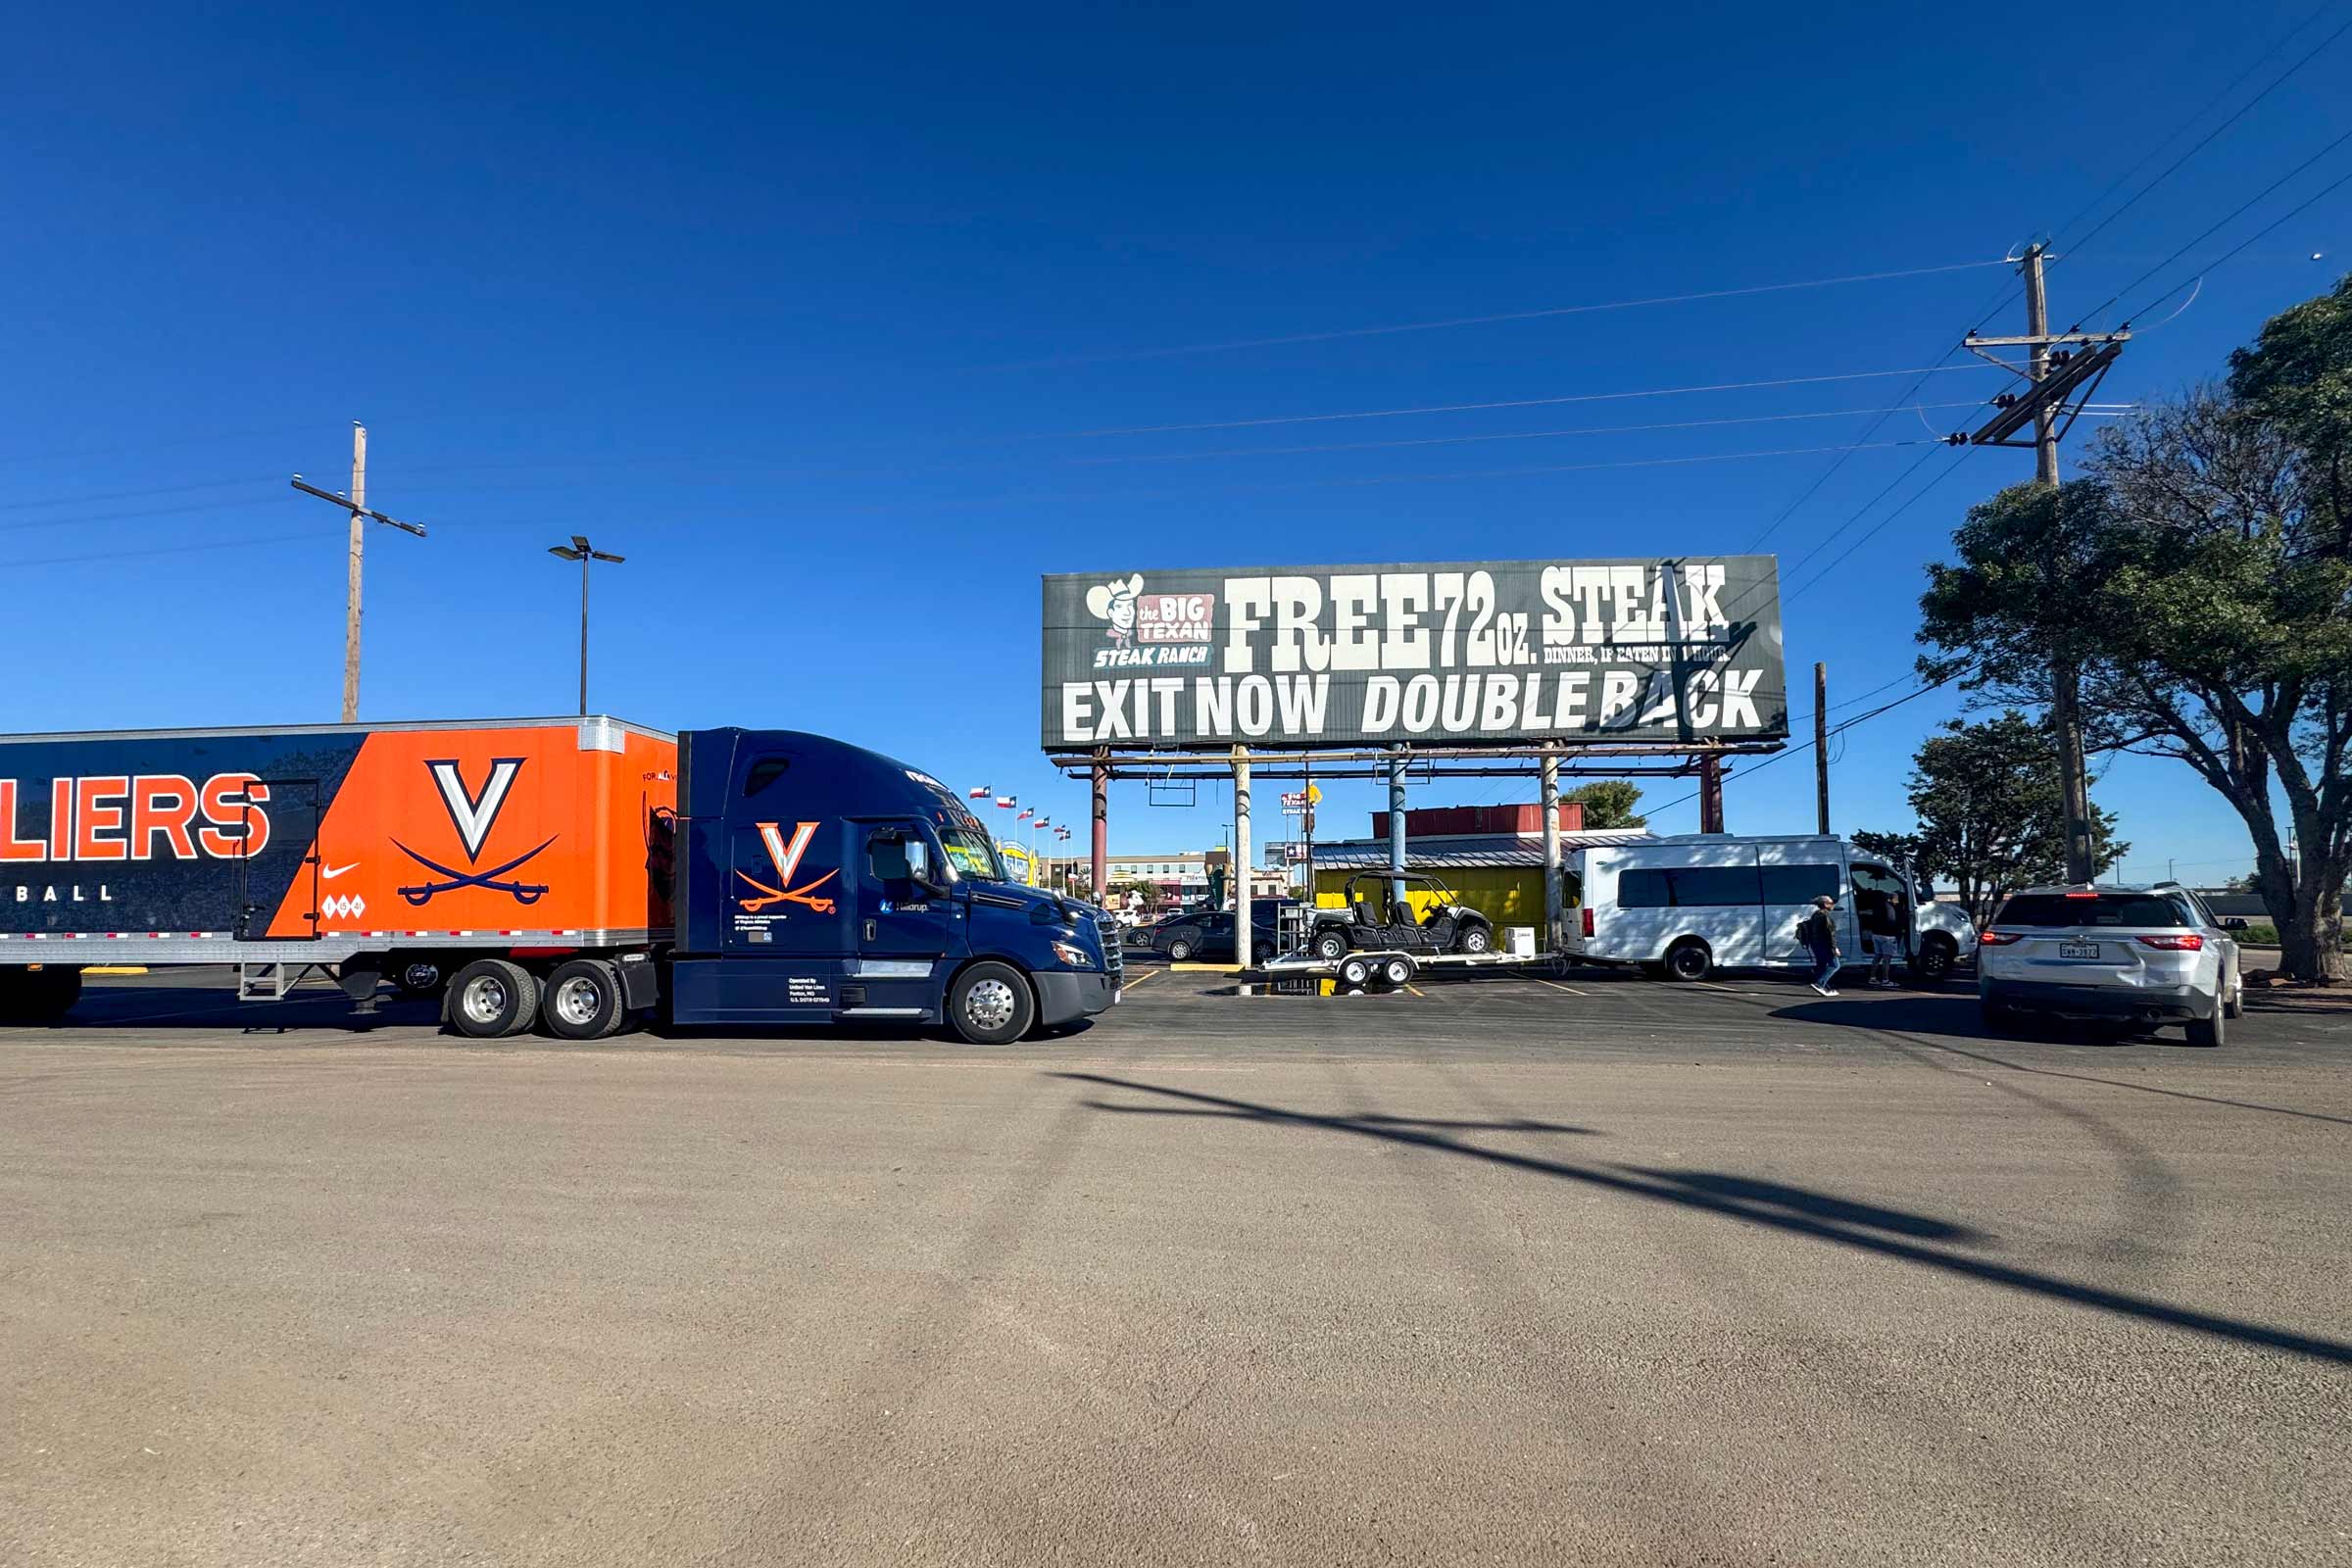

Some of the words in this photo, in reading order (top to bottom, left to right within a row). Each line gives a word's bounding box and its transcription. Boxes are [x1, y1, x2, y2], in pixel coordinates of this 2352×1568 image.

[1139, 605, 1158, 620] the
[1159, 596, 1204, 621] BIG
[1224, 572, 1430, 673] FREE
[1541, 564, 1730, 646] STEAK
[1140, 621, 1208, 640] TEXAN
[1093, 647, 1156, 667] STEAK
[1156, 646, 1208, 664] RANCH
[1544, 645, 1598, 665] DINNER,
[1600, 645, 1614, 663] IF
[1616, 645, 1658, 663] EATEN
[1661, 645, 1677, 663] IN
[1062, 676, 1184, 742] EXIT
[1195, 672, 1330, 736] NOW
[1360, 671, 1591, 734] DOUBLE
[1599, 668, 1764, 729] BACK
[15, 884, 113, 902] BALL
